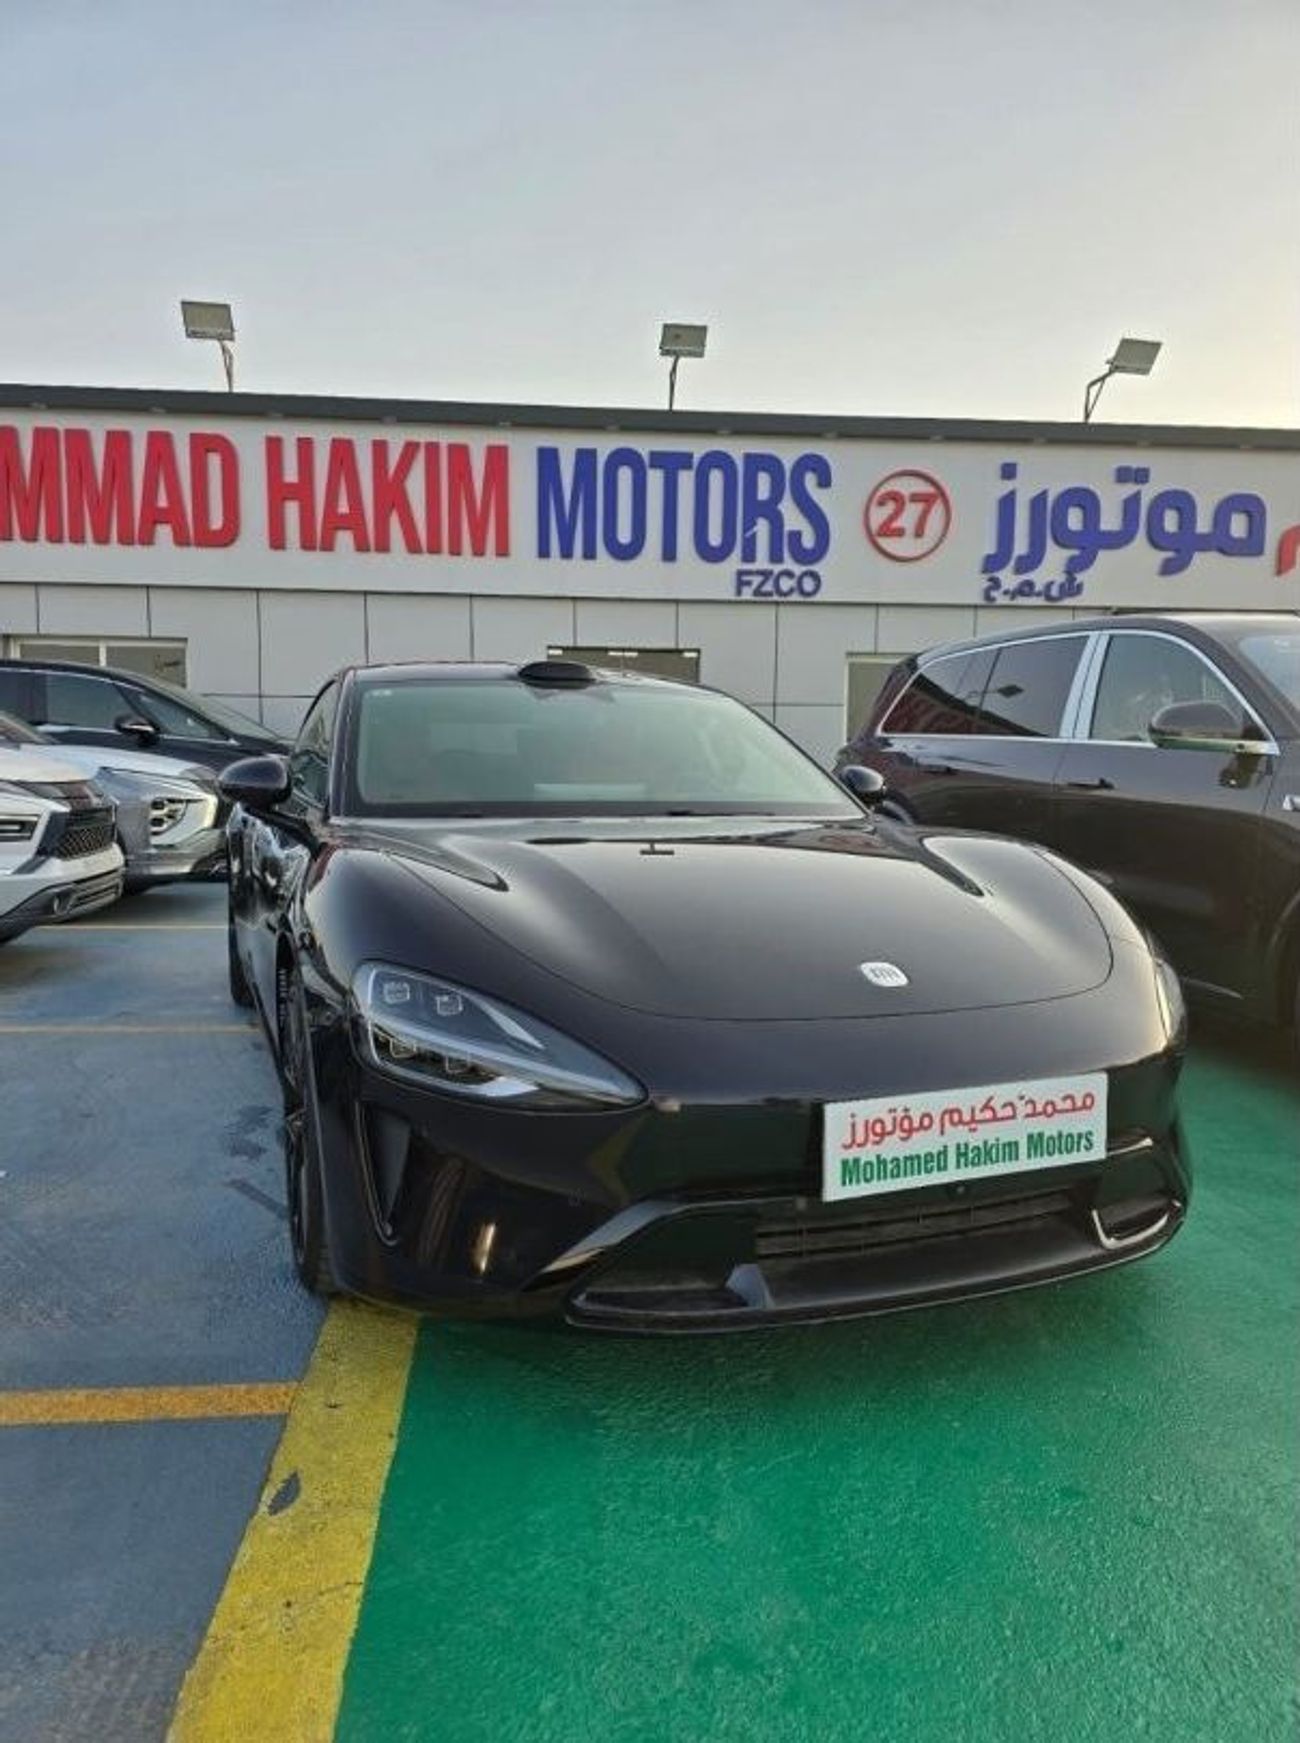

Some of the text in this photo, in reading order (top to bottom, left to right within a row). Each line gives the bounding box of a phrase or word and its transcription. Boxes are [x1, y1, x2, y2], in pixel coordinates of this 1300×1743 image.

[0, 425, 832, 566] MMAD HAKIM MOTORS
[873, 490, 939, 538] 27
[981, 462, 1267, 576] موتورز
[735, 569, 822, 598] FZCO
[939, 1095, 1018, 1136] حكيم
[1023, 1091, 1095, 1119] محمد
[841, 1130, 1095, 1187] Mohamed Hakim Motors
